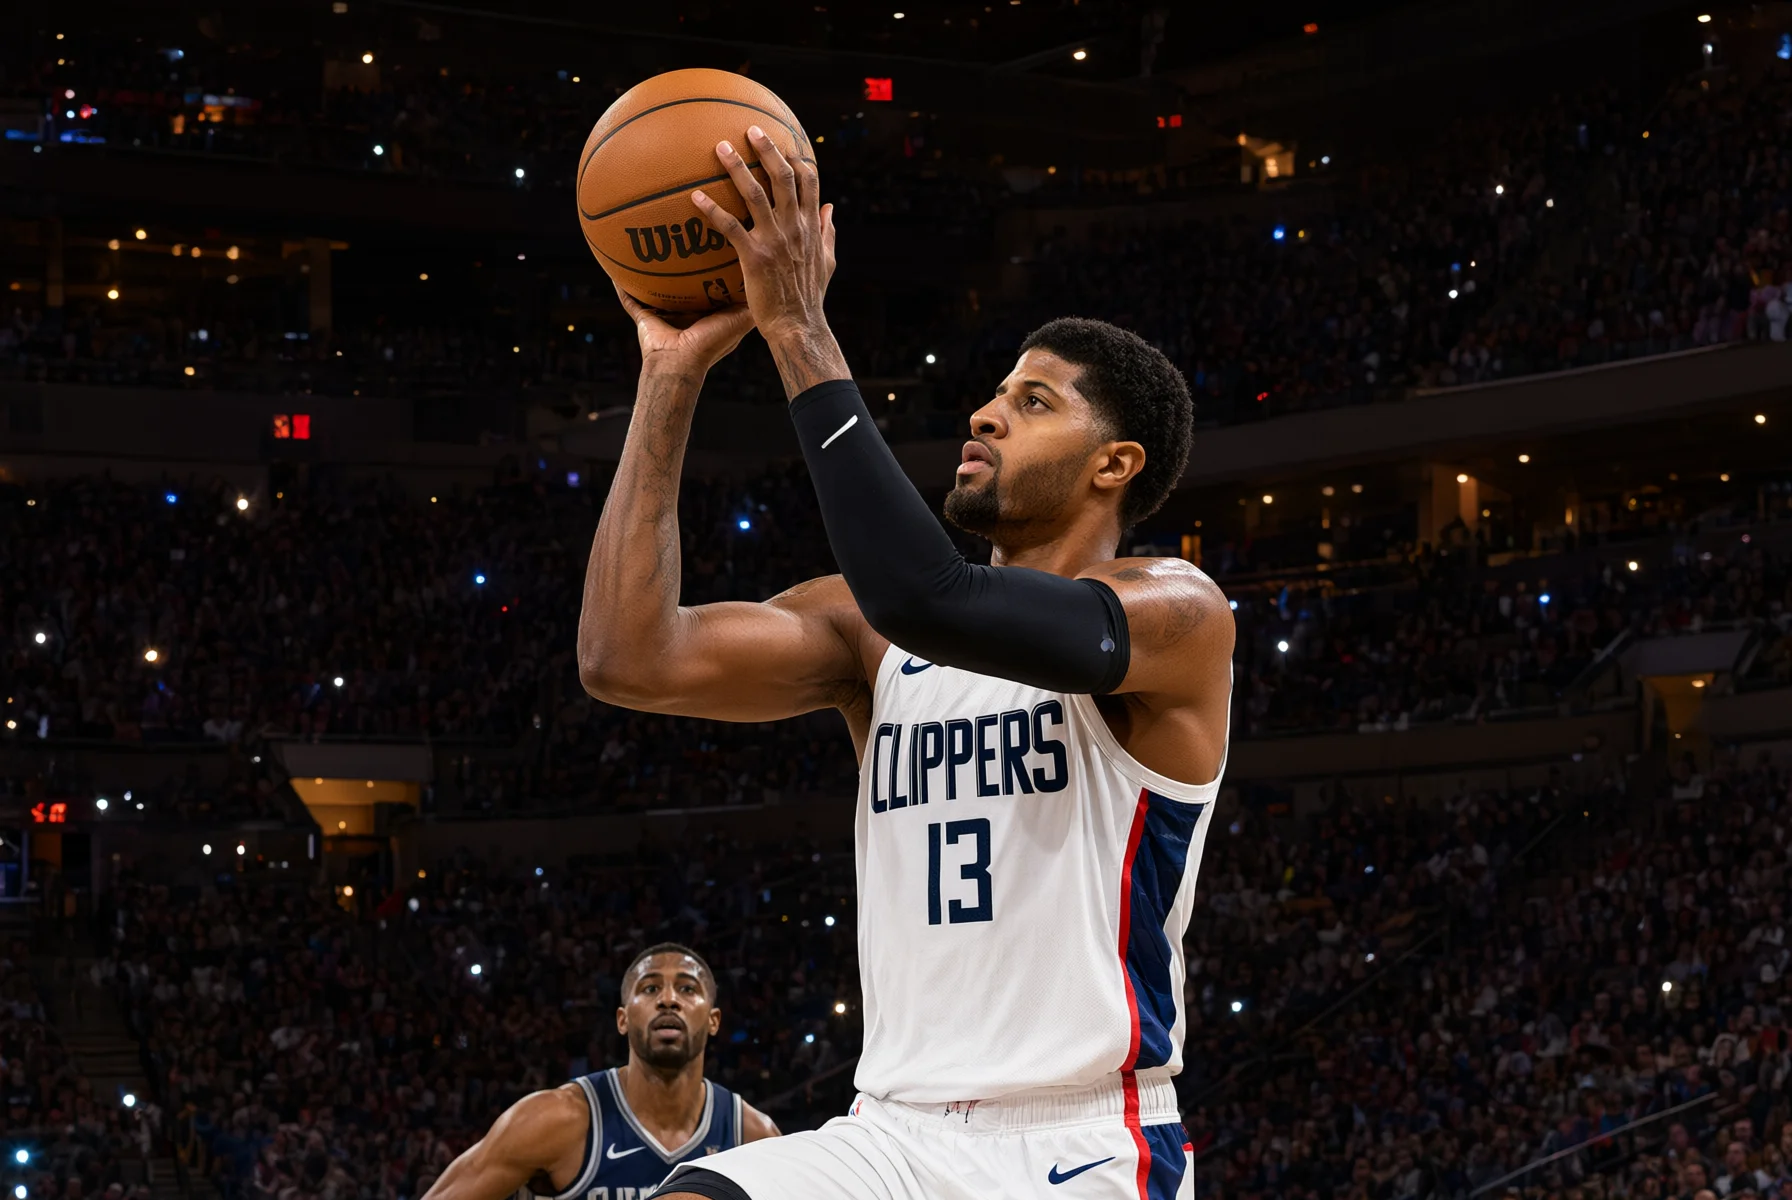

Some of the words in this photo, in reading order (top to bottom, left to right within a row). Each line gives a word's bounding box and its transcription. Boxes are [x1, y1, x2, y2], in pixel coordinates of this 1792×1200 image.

[625, 216, 755, 263] Wils
[871, 699, 1069, 814] CLIPPERS
[928, 818, 993, 925] 13
